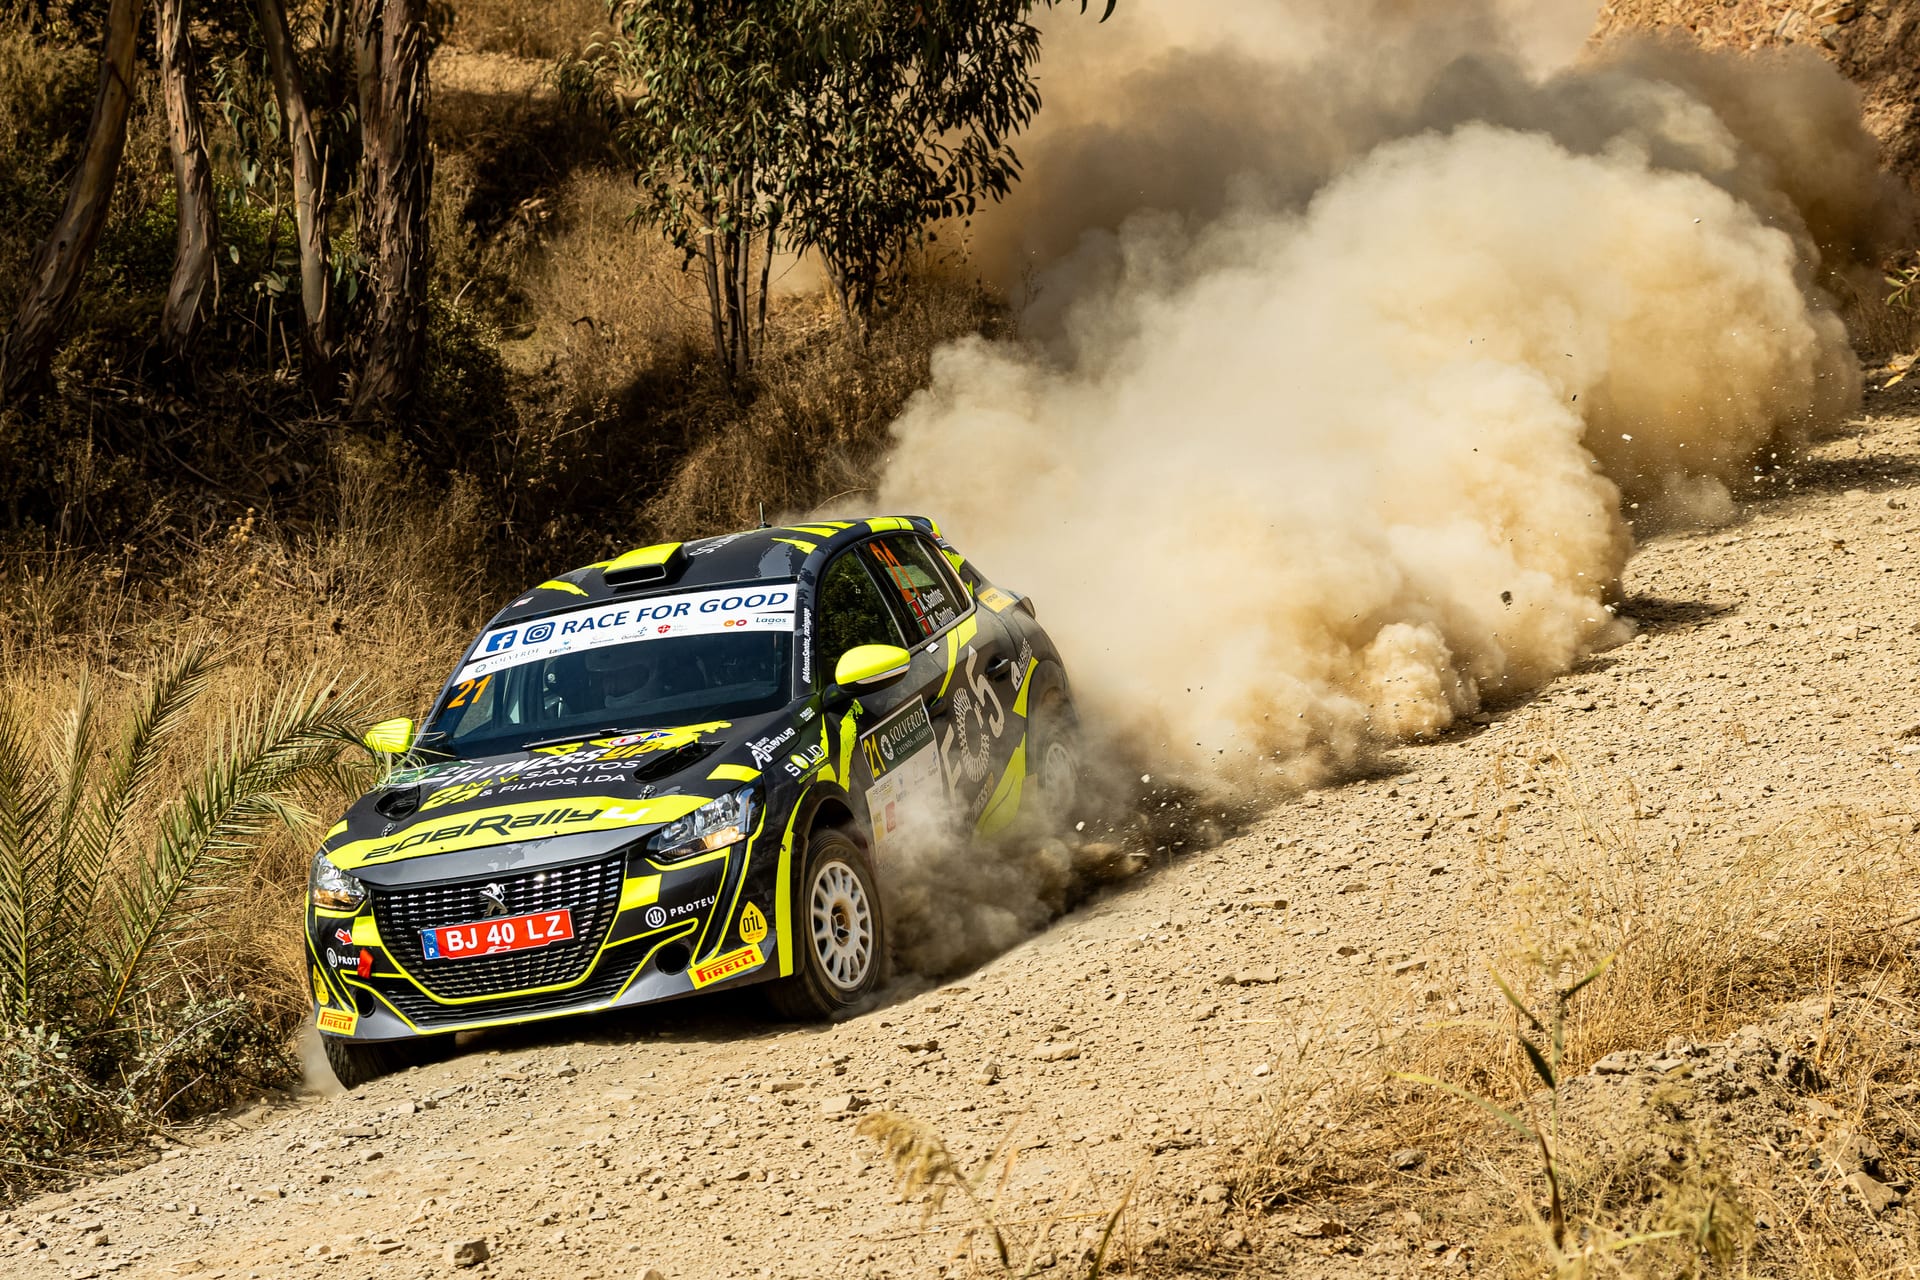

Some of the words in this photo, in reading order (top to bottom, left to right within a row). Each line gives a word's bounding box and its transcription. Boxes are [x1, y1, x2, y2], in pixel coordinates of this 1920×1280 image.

[561, 610, 630, 636] RACE
[636, 602, 691, 623] FOR
[700, 592, 789, 613] GOOD
[922, 588, 945, 609] Santos
[446, 674, 493, 710] 21
[889, 707, 927, 745] SOLVERDE
[522, 760, 641, 779] SANTOS
[863, 734, 887, 778] 21
[582, 774, 626, 784] LDA
[669, 895, 716, 918] PROTEU
[428, 947, 435, 957] P
[446, 927, 478, 951] BJ
[486, 922, 516, 945] 40
[696, 949, 756, 983] PIRELLI
[320, 1011, 353, 1031] PIRELLI
